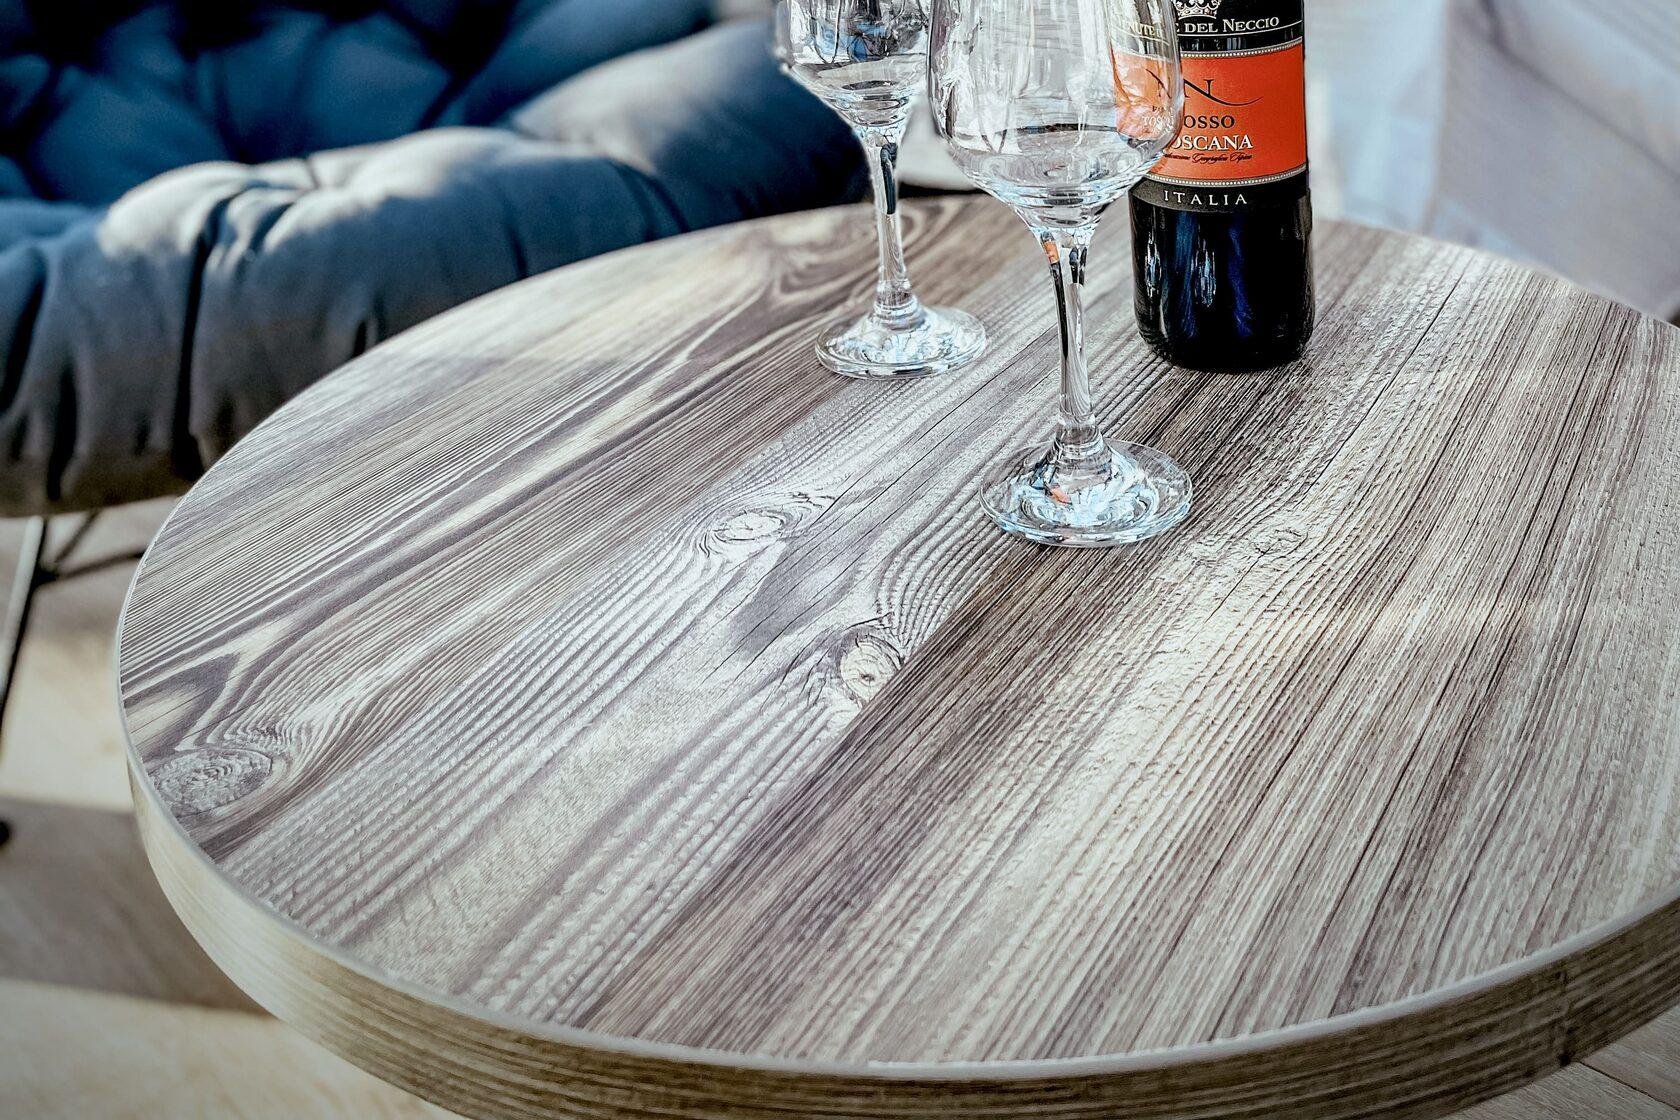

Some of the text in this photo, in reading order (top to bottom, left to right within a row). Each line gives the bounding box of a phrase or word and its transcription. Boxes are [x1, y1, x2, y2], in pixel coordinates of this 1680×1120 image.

[1184, 22, 1219, 33] DEL
[1183, 114, 1236, 129] OSSO
[1170, 134, 1254, 151] OSCANA
[1164, 190, 1248, 206] ITALIA
